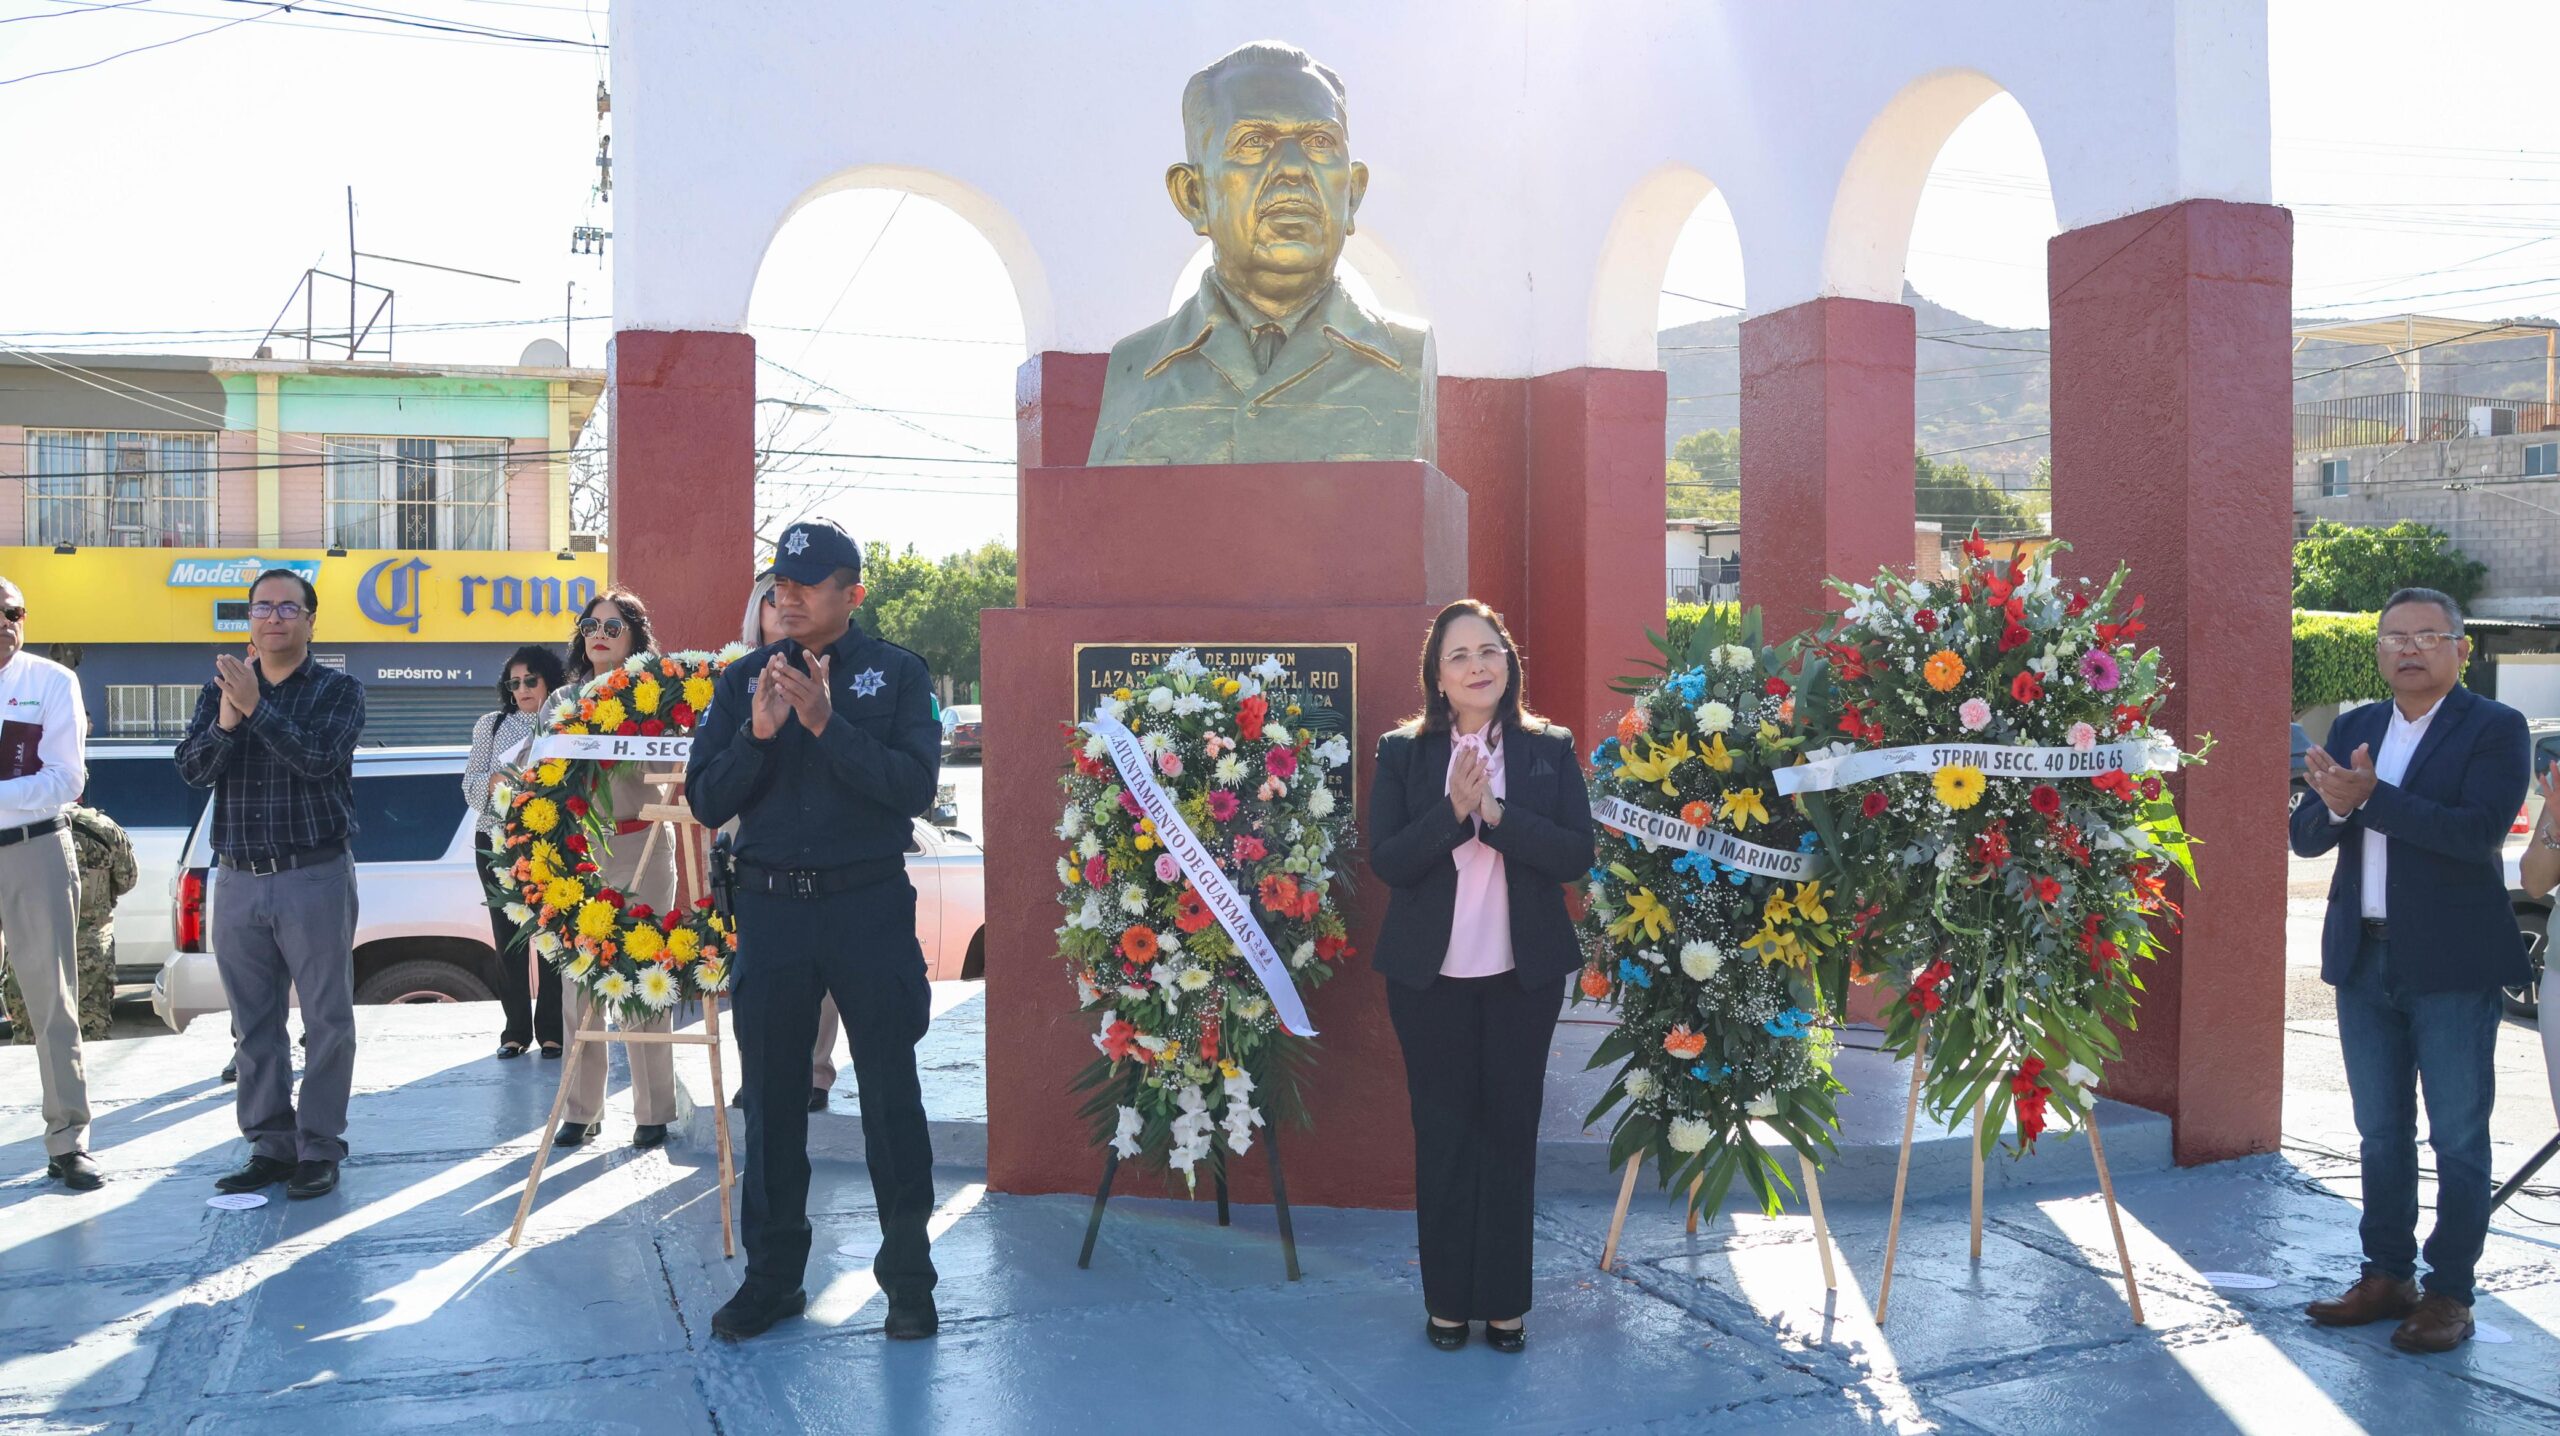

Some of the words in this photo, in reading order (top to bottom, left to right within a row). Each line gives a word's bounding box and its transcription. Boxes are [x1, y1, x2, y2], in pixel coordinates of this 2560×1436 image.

[217, 622, 249, 631] EXTRA
[1205, 652, 1224, 666] DE
[1230, 652, 1296, 666] DIVISON
[378, 667, 443, 680] DEPÓSITO
[465, 670, 472, 680] 1
[1091, 670, 1157, 689] LAZAR
[1310, 671, 1339, 689] RIO
[613, 740, 636, 756] H.
[645, 741, 691, 757] SEC
[1931, 749, 1988, 769] STPRM
[1993, 751, 2038, 771] SECC.
[2044, 752, 2064, 771] 40
[2069, 751, 2105, 771] DELG
[2109, 749, 2123, 769] 65
[1112, 738, 1186, 849] AYUNTAMIENTO
[1181, 846, 1205, 872] DE
[1199, 870, 1256, 943] GUAYMAS
[1621, 807, 1692, 843] SECCION
[1696, 830, 1716, 851] 01
[1719, 840, 1803, 874] MARINOS
